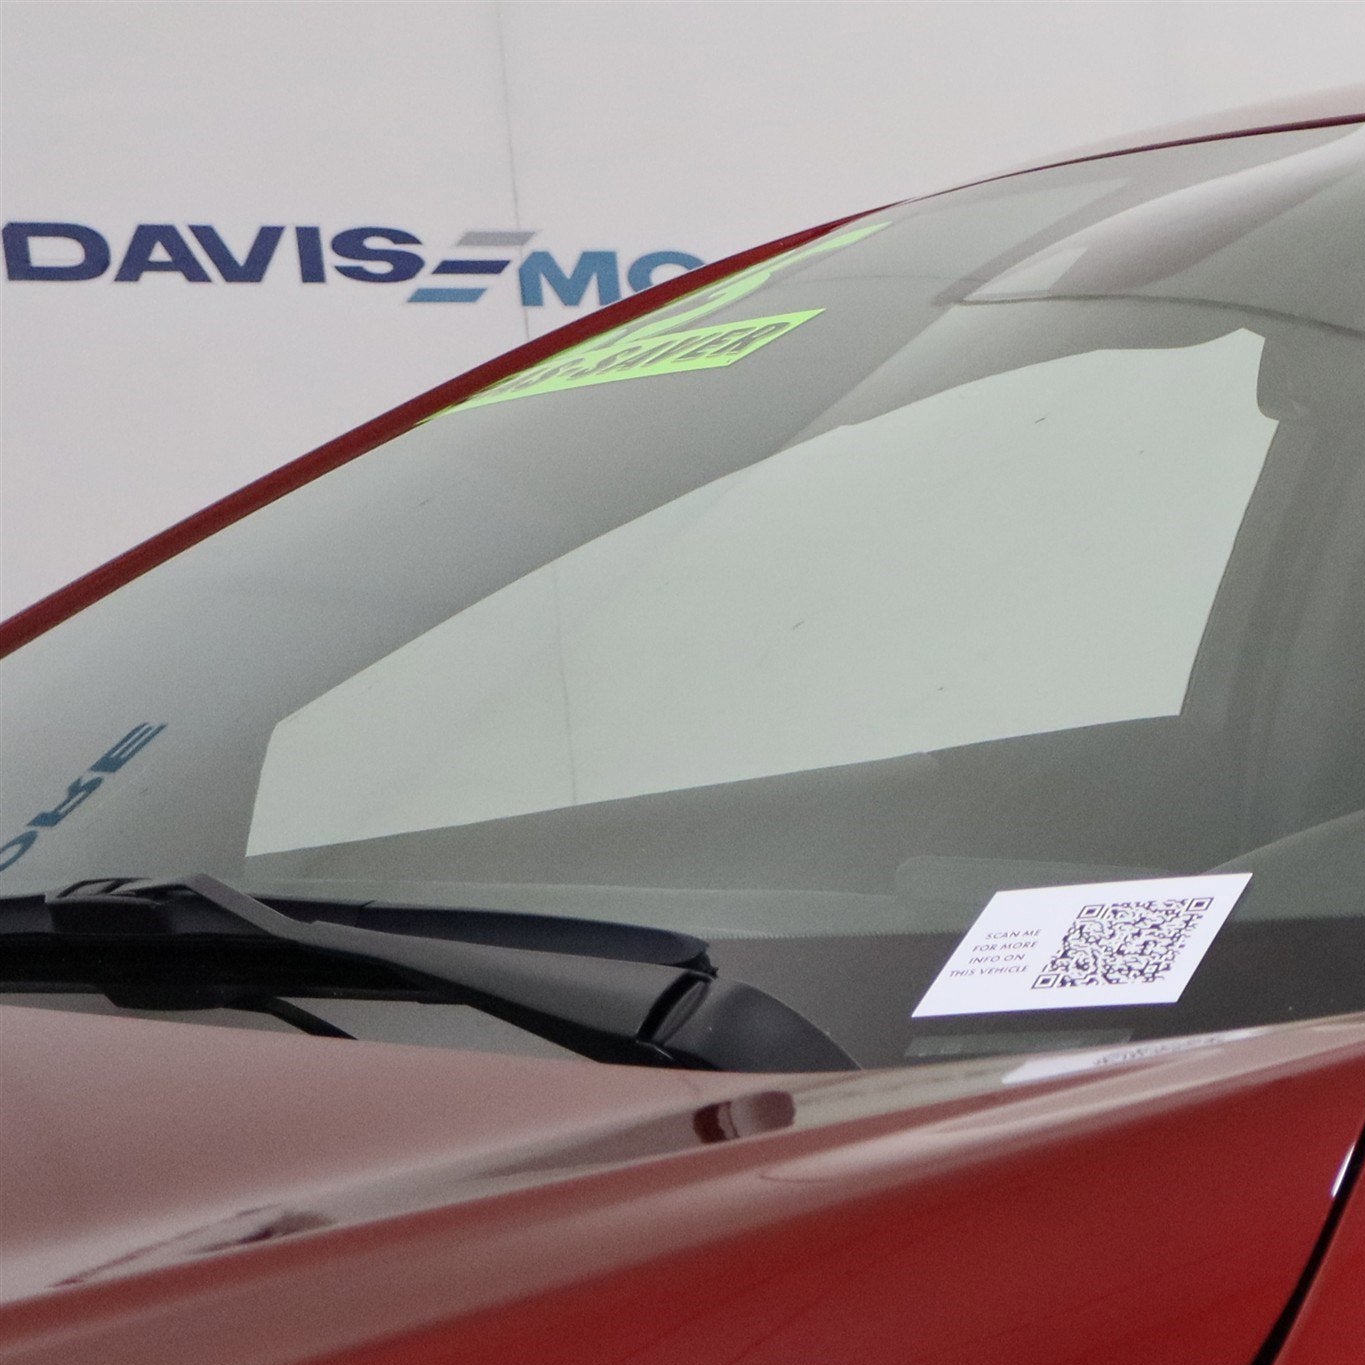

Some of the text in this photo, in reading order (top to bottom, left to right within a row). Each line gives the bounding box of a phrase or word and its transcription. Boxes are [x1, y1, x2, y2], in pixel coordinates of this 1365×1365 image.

[2, 222, 427, 284] DAVIS
[985, 928, 1042, 940] SCAN ME
[972, 941, 1038, 952] FOR MORE
[968, 956, 1000, 964] INFO
[949, 965, 1029, 977] THIS VEHICLE
